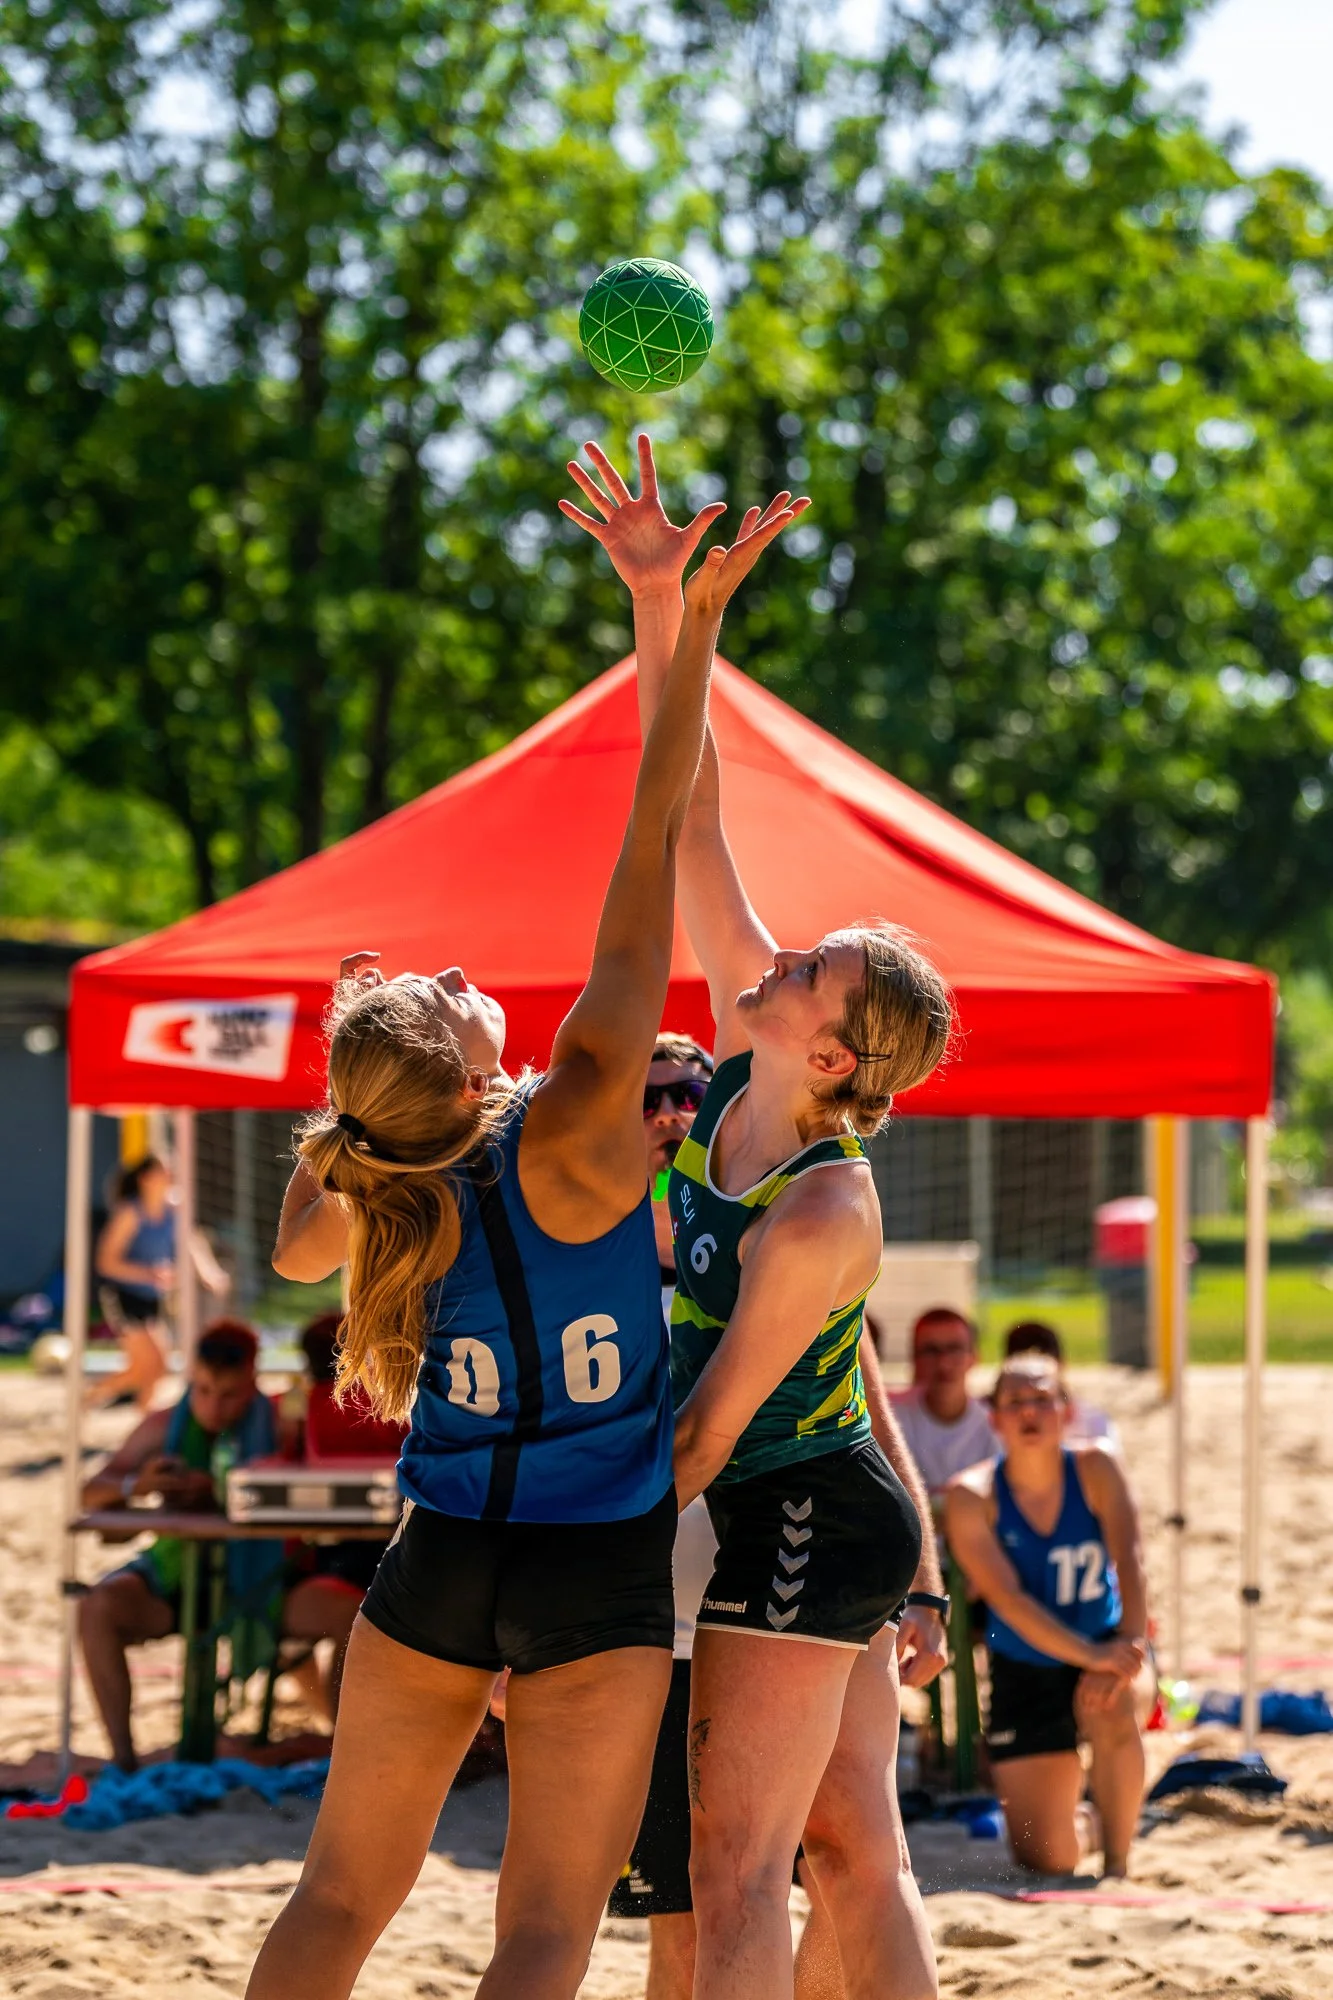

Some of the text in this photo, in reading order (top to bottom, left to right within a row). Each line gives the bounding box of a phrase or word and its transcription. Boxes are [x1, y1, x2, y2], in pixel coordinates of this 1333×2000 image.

[680, 1183, 696, 1225] SUI
[690, 1233, 718, 1275] 6
[1047, 1541, 1107, 1606] 12
[704, 1597, 747, 1613] hummel
